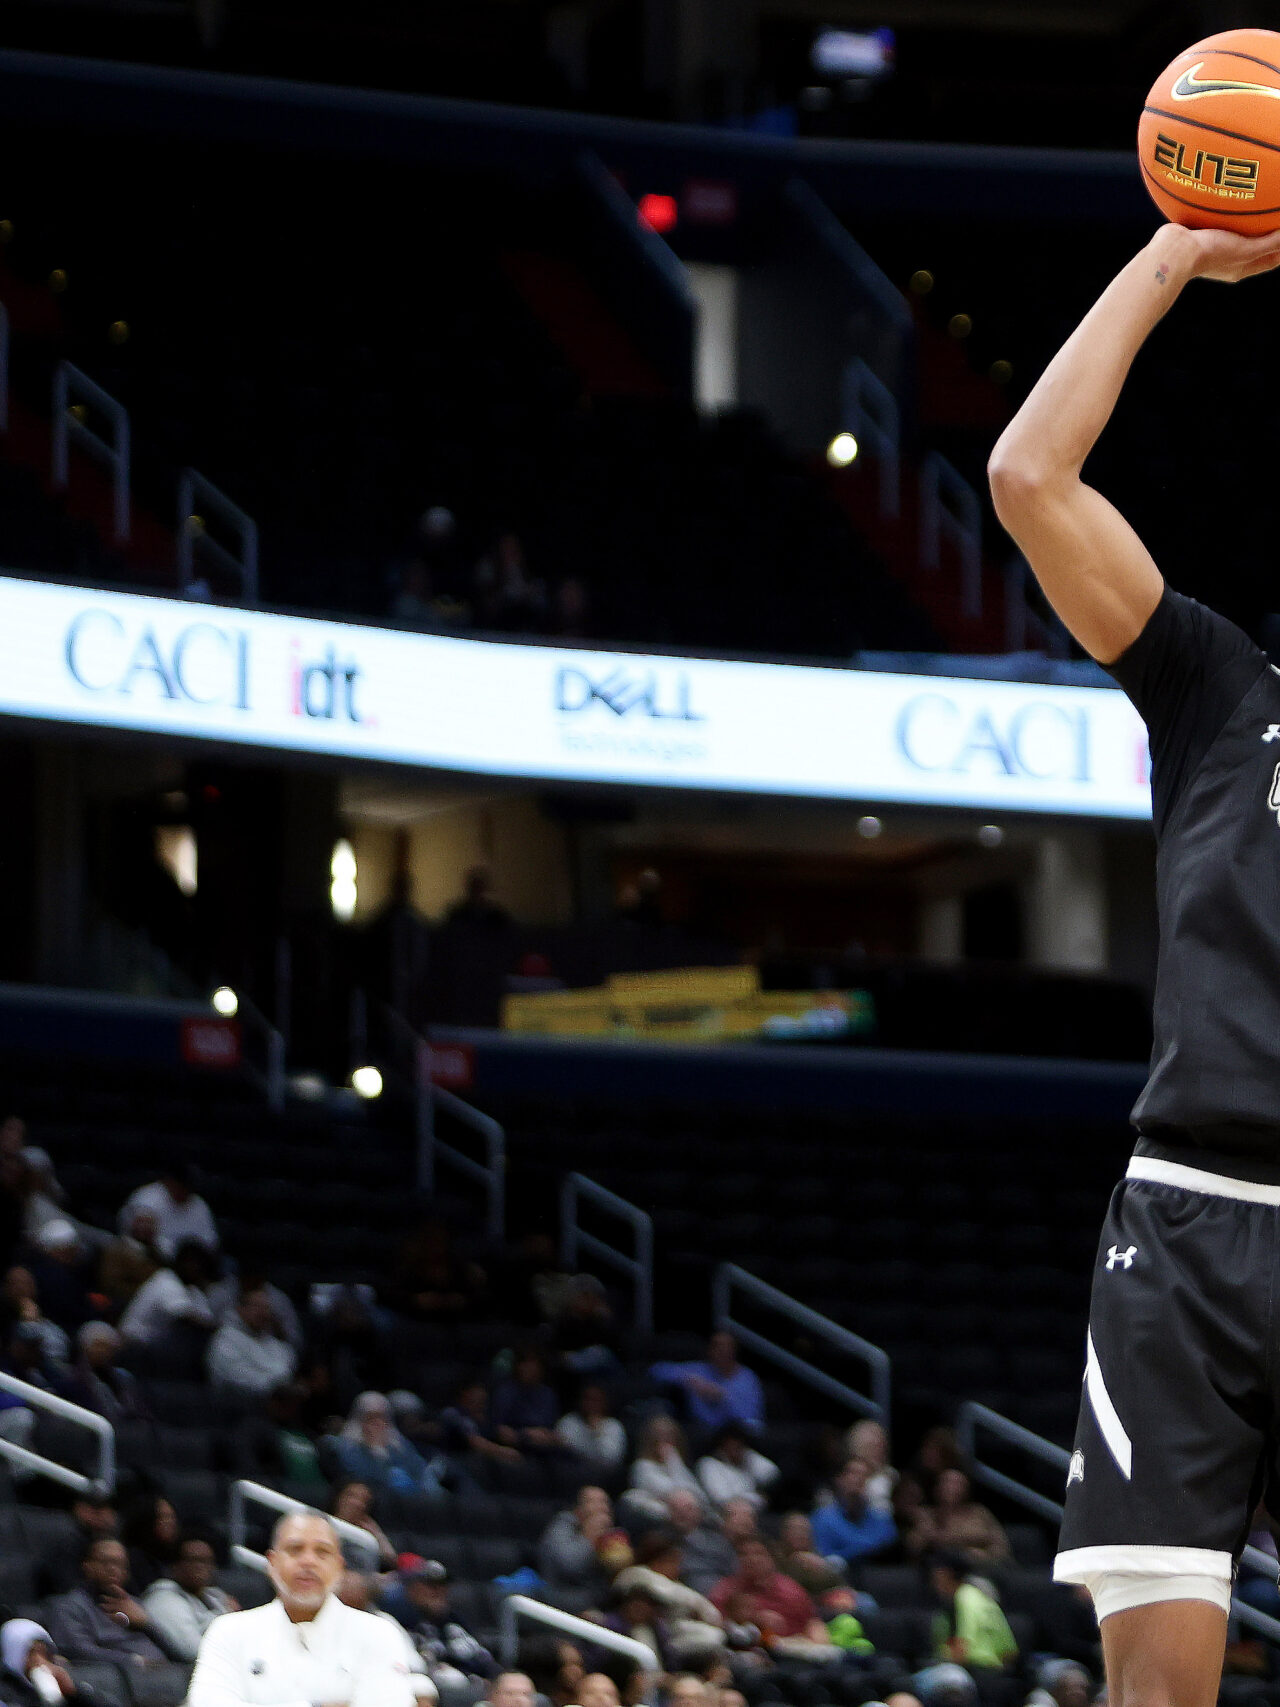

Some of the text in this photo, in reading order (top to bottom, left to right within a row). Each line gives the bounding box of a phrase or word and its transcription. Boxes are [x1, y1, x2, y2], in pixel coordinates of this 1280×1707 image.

[1155, 131, 1260, 191] ELITE
[62, 607, 252, 710] CACI
[556, 662, 708, 721] DELL
[895, 691, 1095, 784] CACI
